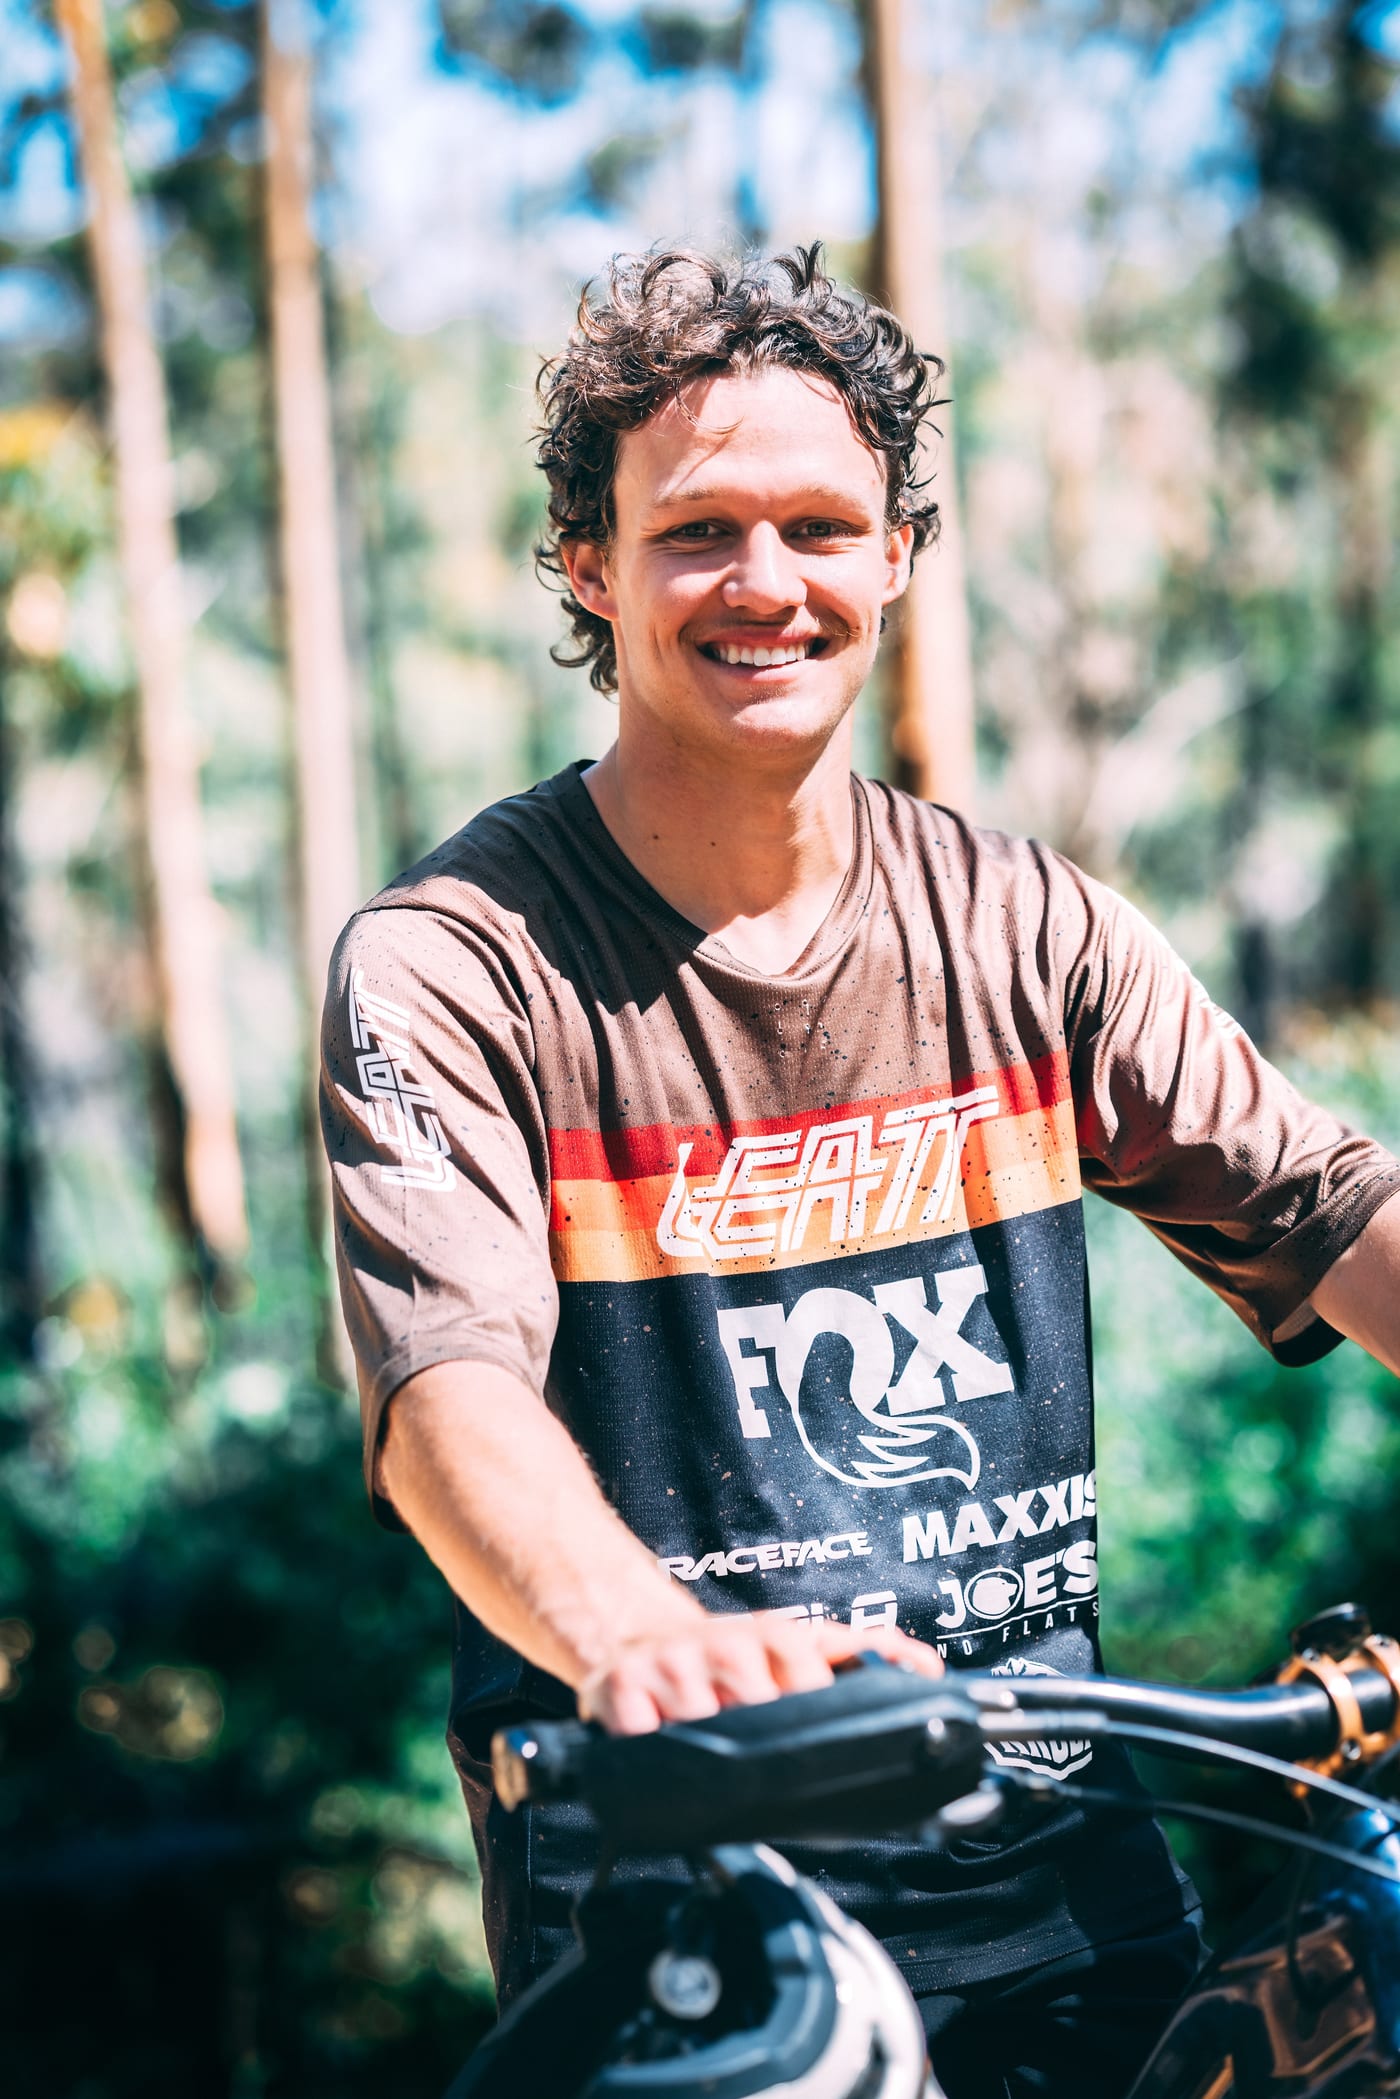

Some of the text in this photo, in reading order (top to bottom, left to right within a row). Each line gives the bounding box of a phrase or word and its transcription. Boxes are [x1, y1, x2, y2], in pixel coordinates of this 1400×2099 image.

[349, 967, 457, 1193] LEATT
[656, 1085, 999, 1260] LEATT
[716, 1264, 1015, 1491] FOX
[656, 1531, 873, 1583] RACEFACE
